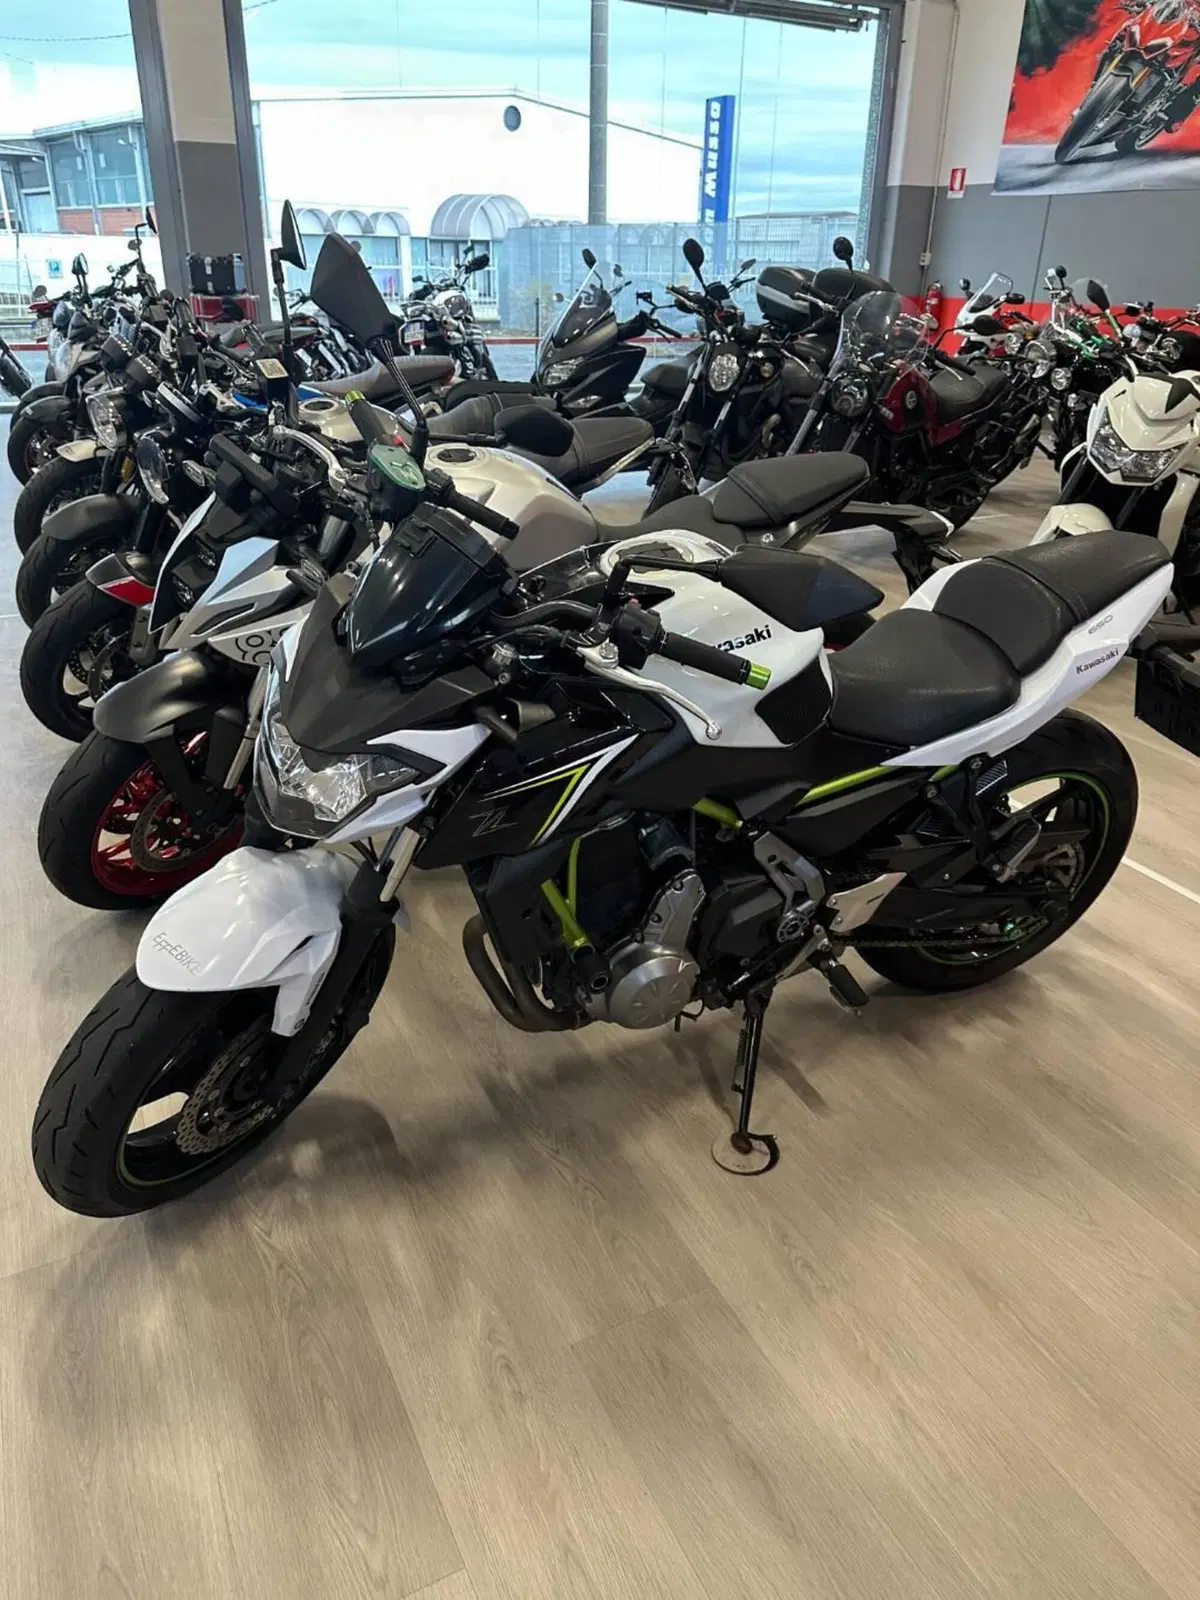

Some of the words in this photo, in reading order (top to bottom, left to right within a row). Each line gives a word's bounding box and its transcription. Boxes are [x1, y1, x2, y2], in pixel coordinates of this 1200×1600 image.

[704, 100, 721, 198] Musso
[1088, 614, 1113, 634] 650
[712, 624, 772, 652] asaki
[1076, 647, 1119, 674] Kawasaki
